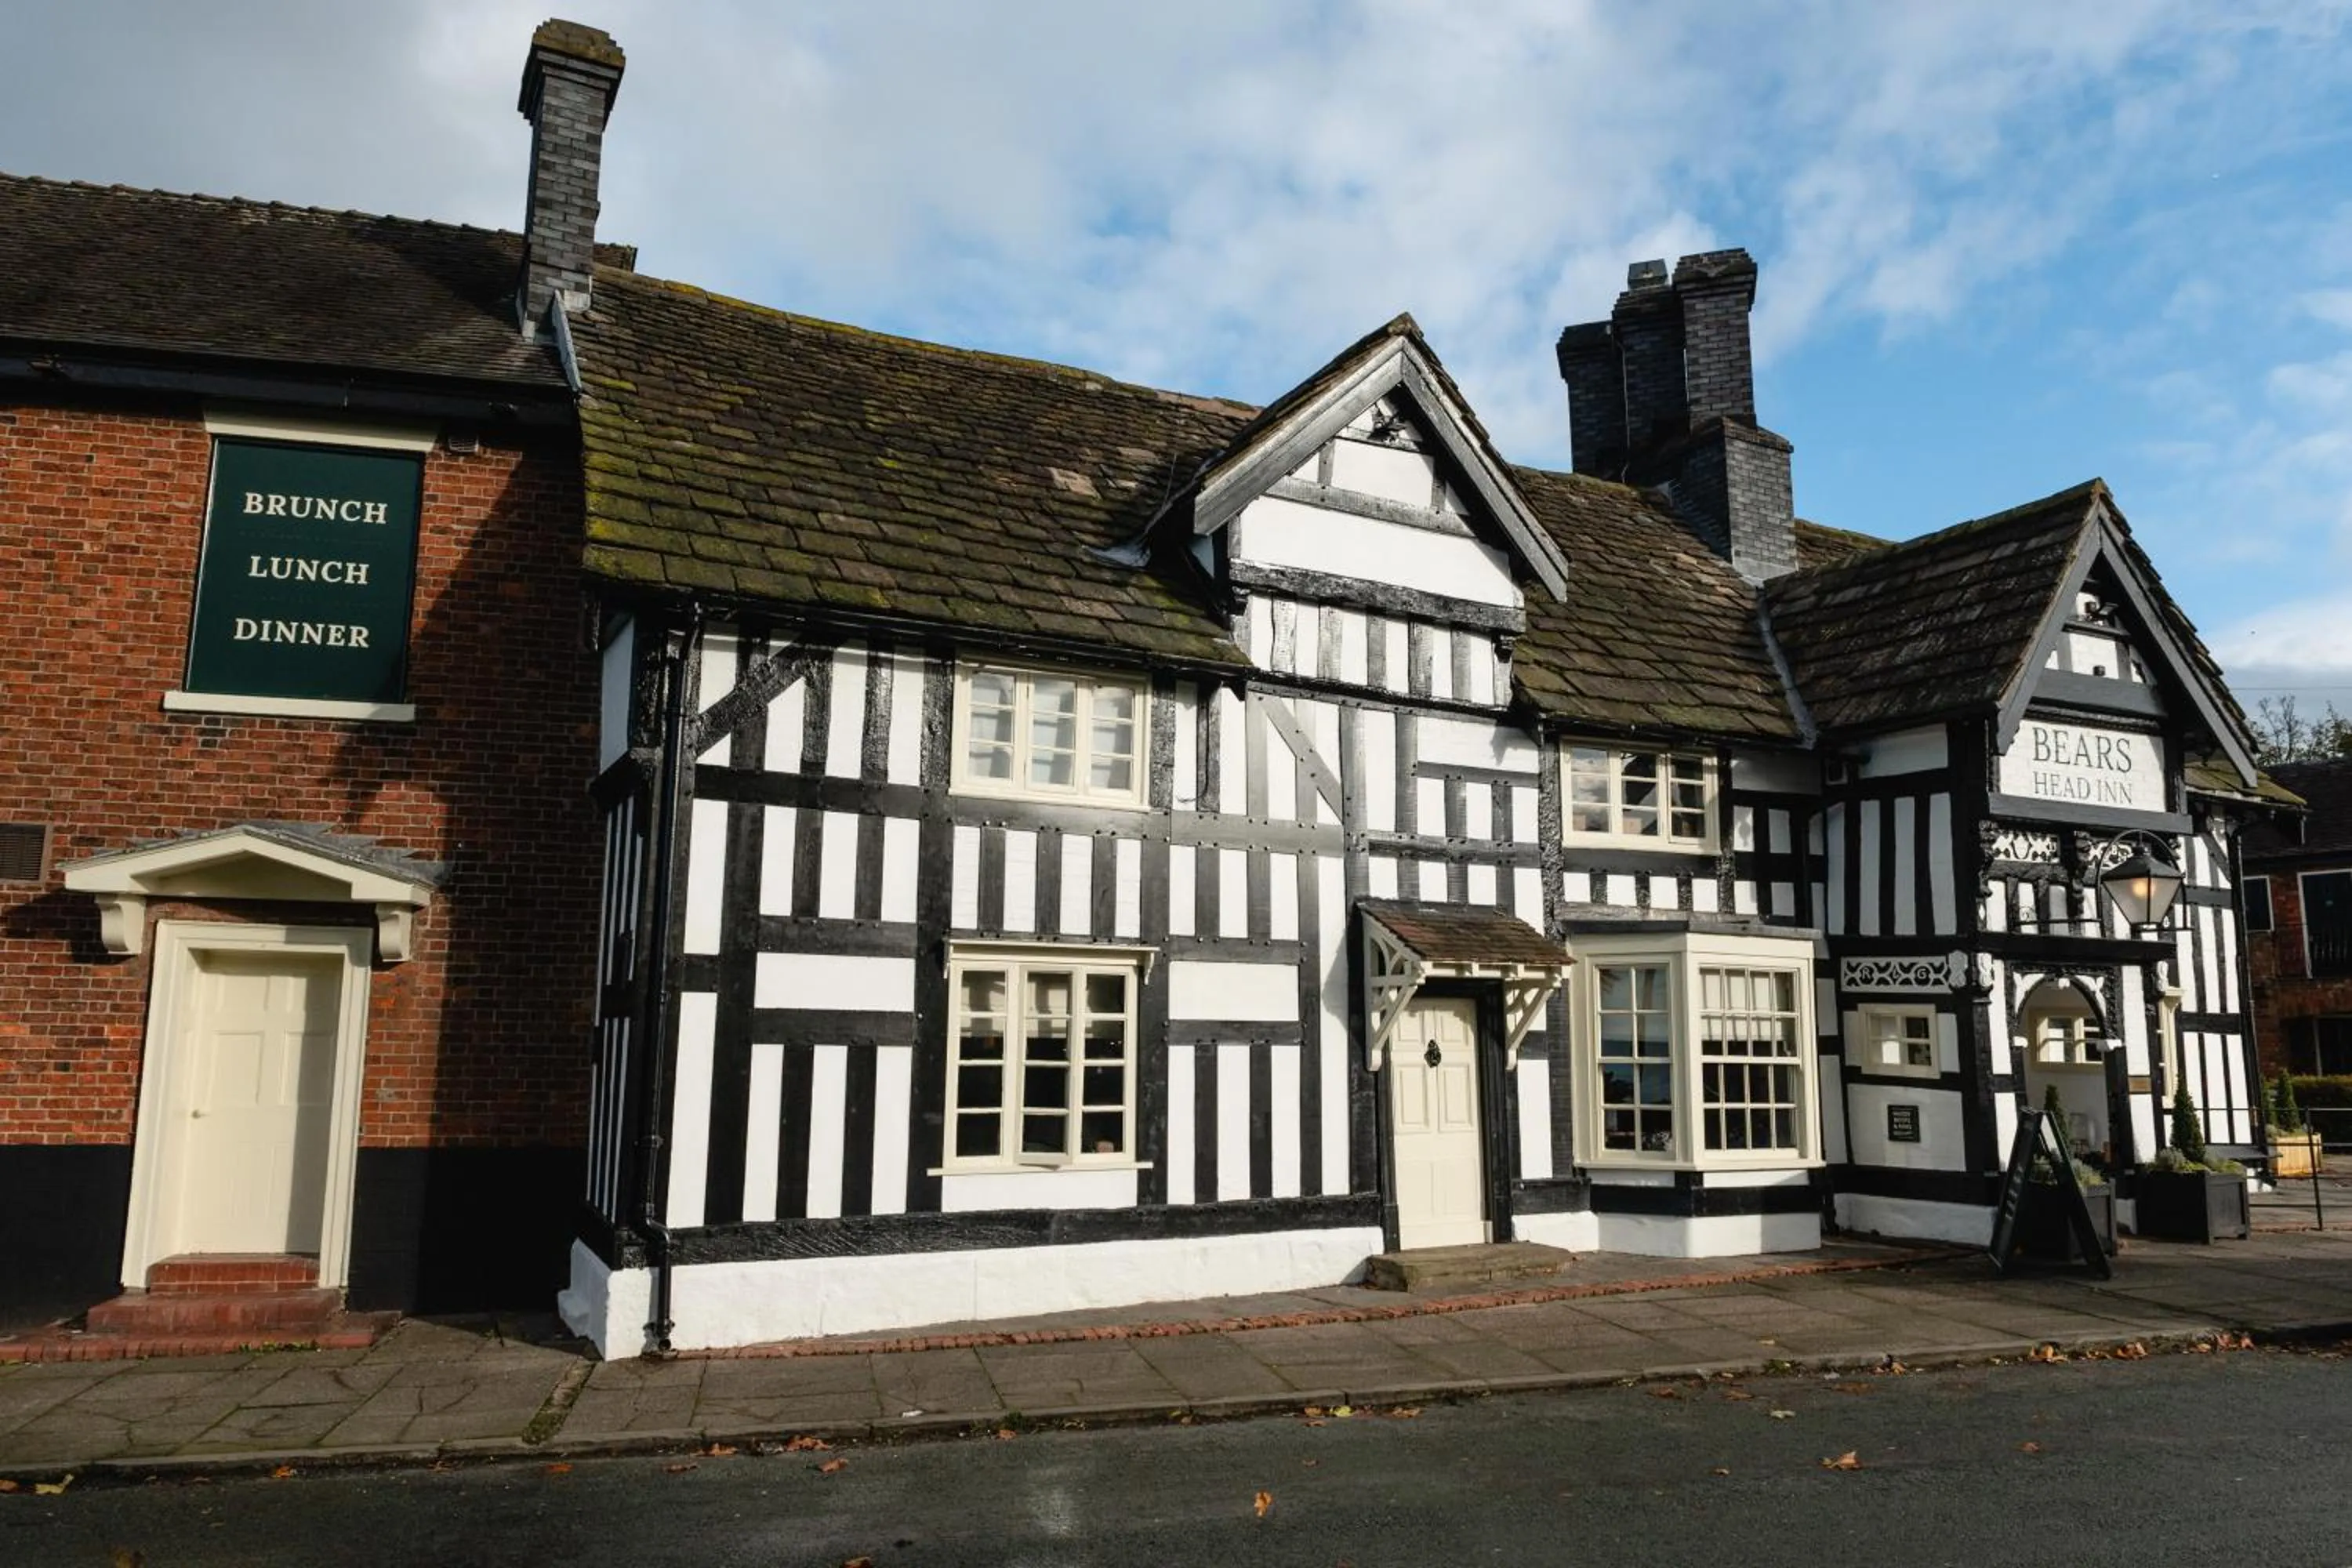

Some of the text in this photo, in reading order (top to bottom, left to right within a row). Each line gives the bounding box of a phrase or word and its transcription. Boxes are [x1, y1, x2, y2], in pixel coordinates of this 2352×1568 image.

[243, 492, 389, 524] BRUNCH
[248, 555, 370, 585] LUNCH
[234, 618, 370, 648] DINNER
[2032, 726, 2132, 773] BEARS
[2033, 771, 2133, 805] HEAD INN
